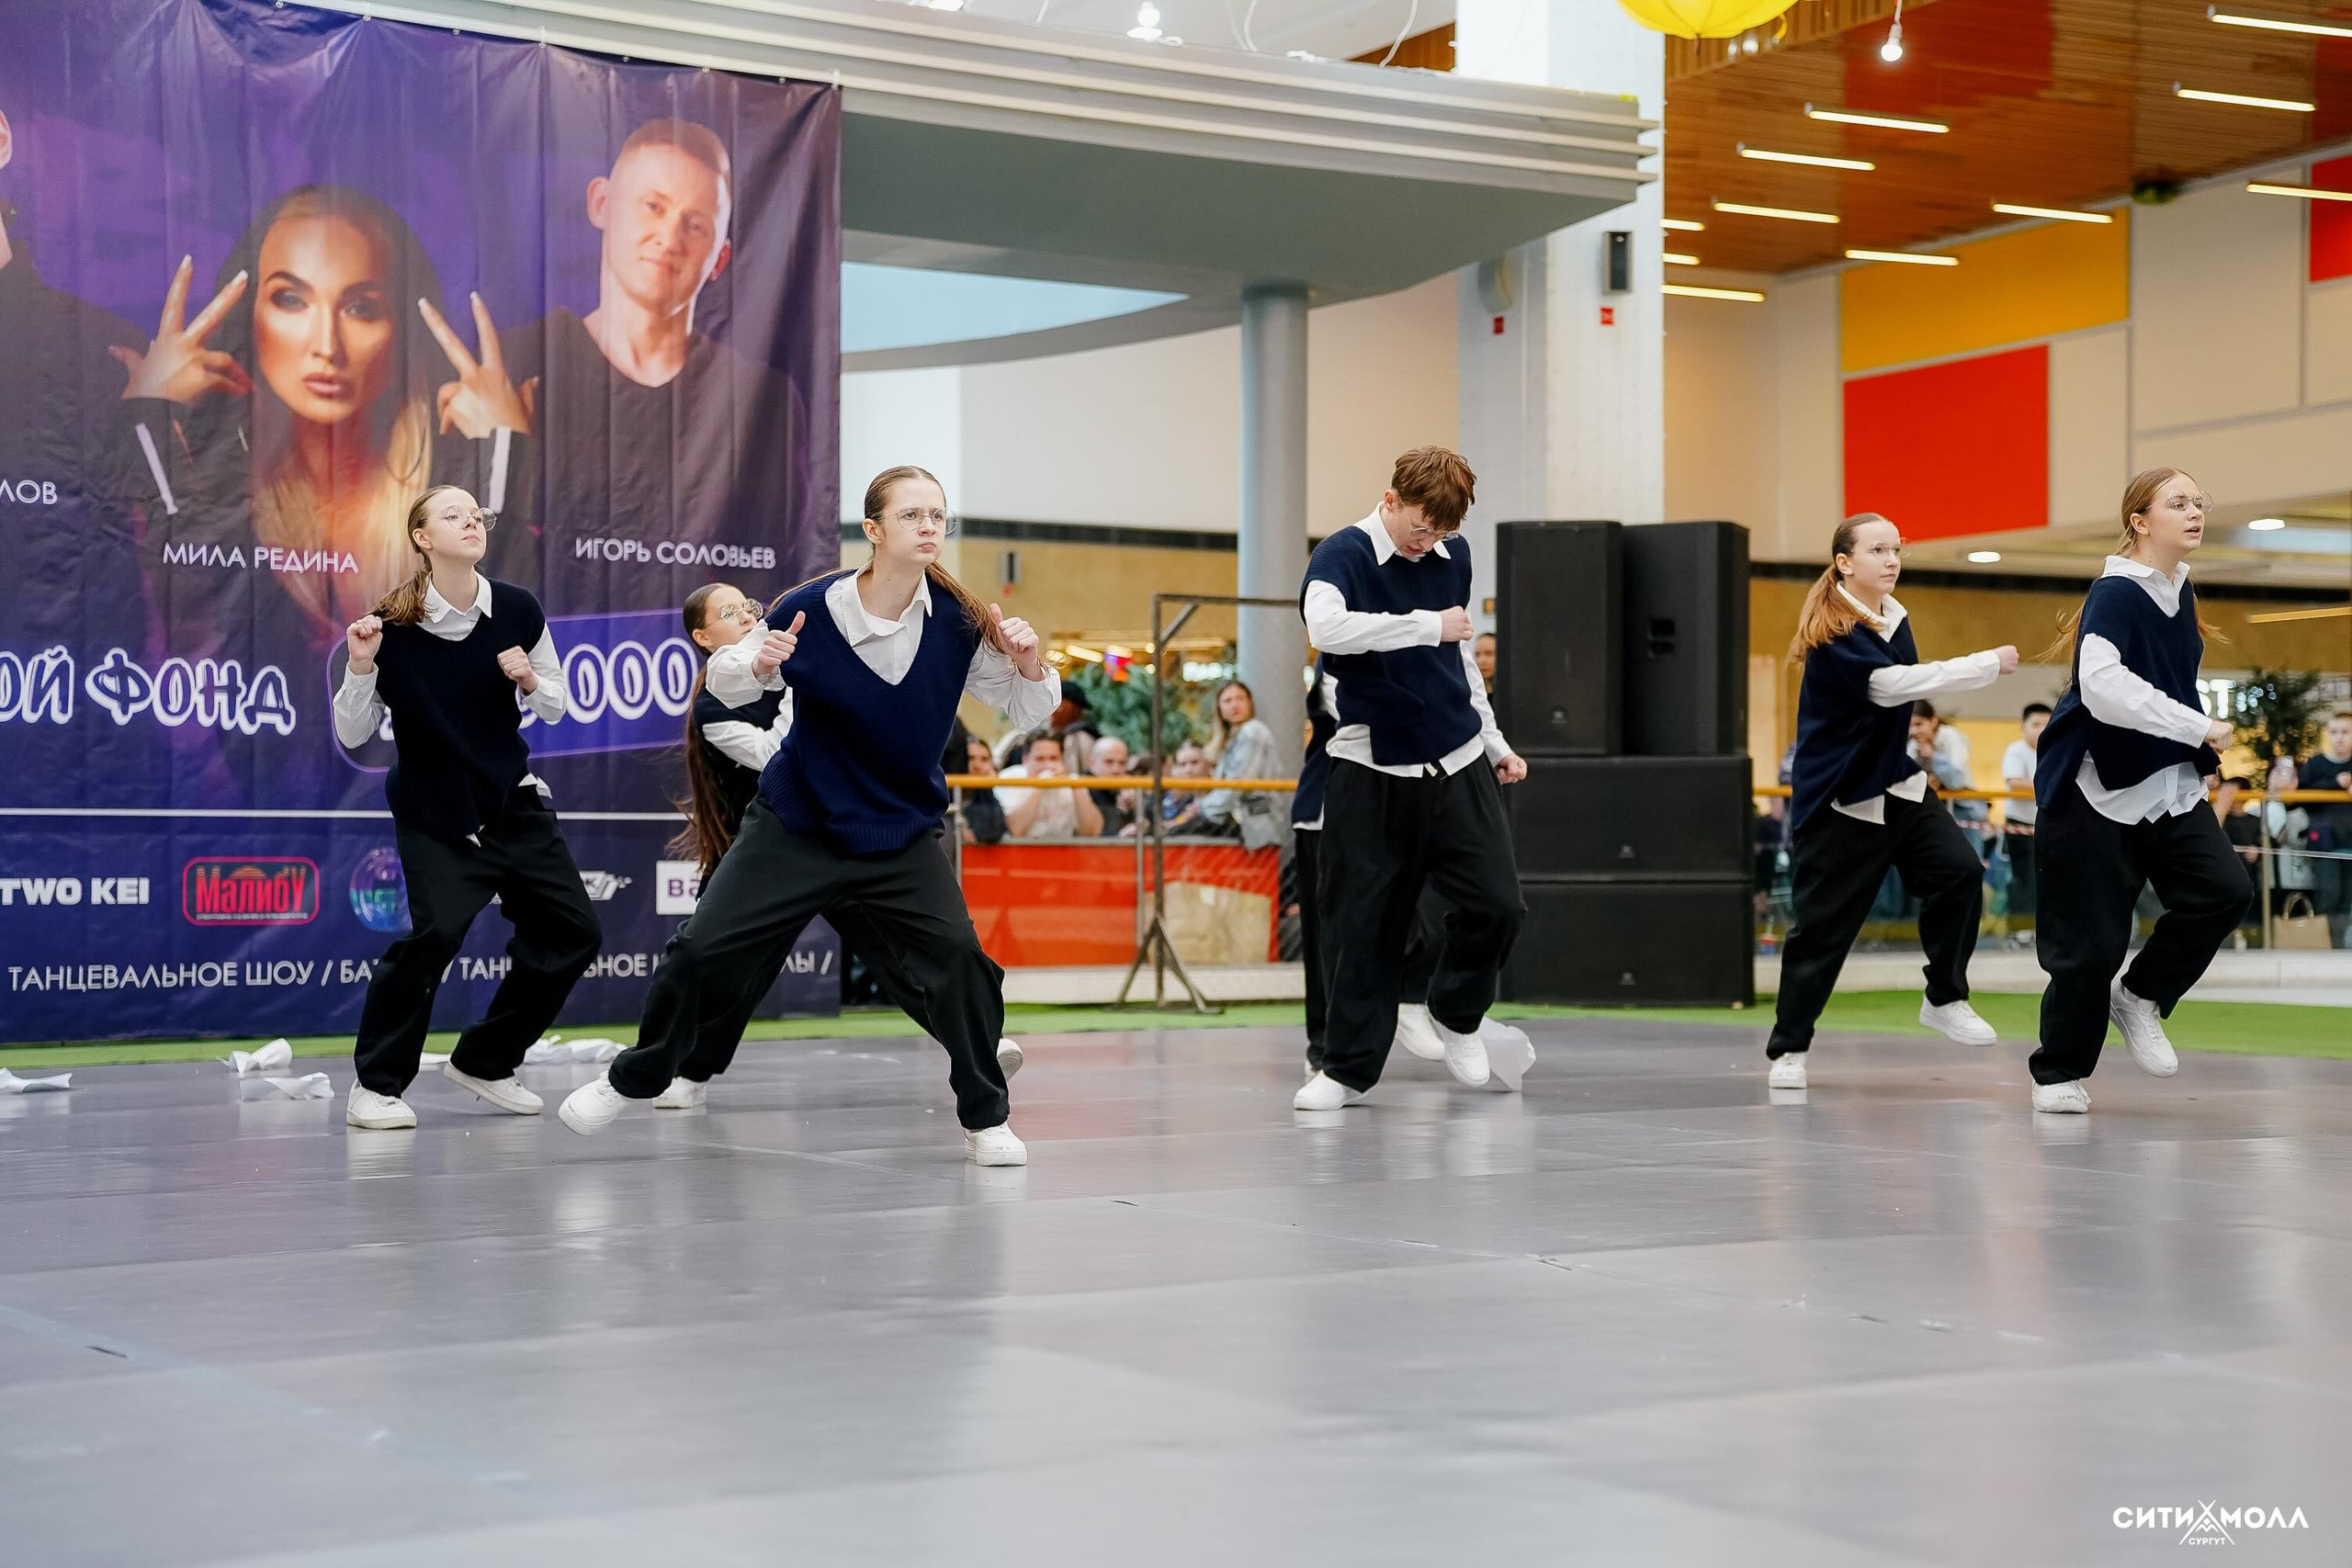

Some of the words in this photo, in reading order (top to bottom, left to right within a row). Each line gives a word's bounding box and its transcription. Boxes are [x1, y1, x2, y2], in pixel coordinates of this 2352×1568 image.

[163, 542, 246, 569] МИЛА
[254, 546, 359, 574] РЕДИНА
[575, 537, 651, 563] ИГОРЬ
[656, 540, 776, 569] СОЛОВЬЕВ
[85, 648, 296, 736] ФОНД
[0, 877, 83, 906] TWO
[90, 877, 151, 905] KEI
[7, 961, 238, 992] ТАНЦЕВАЛЬНОЕ
[245, 960, 315, 986] ШОУ
